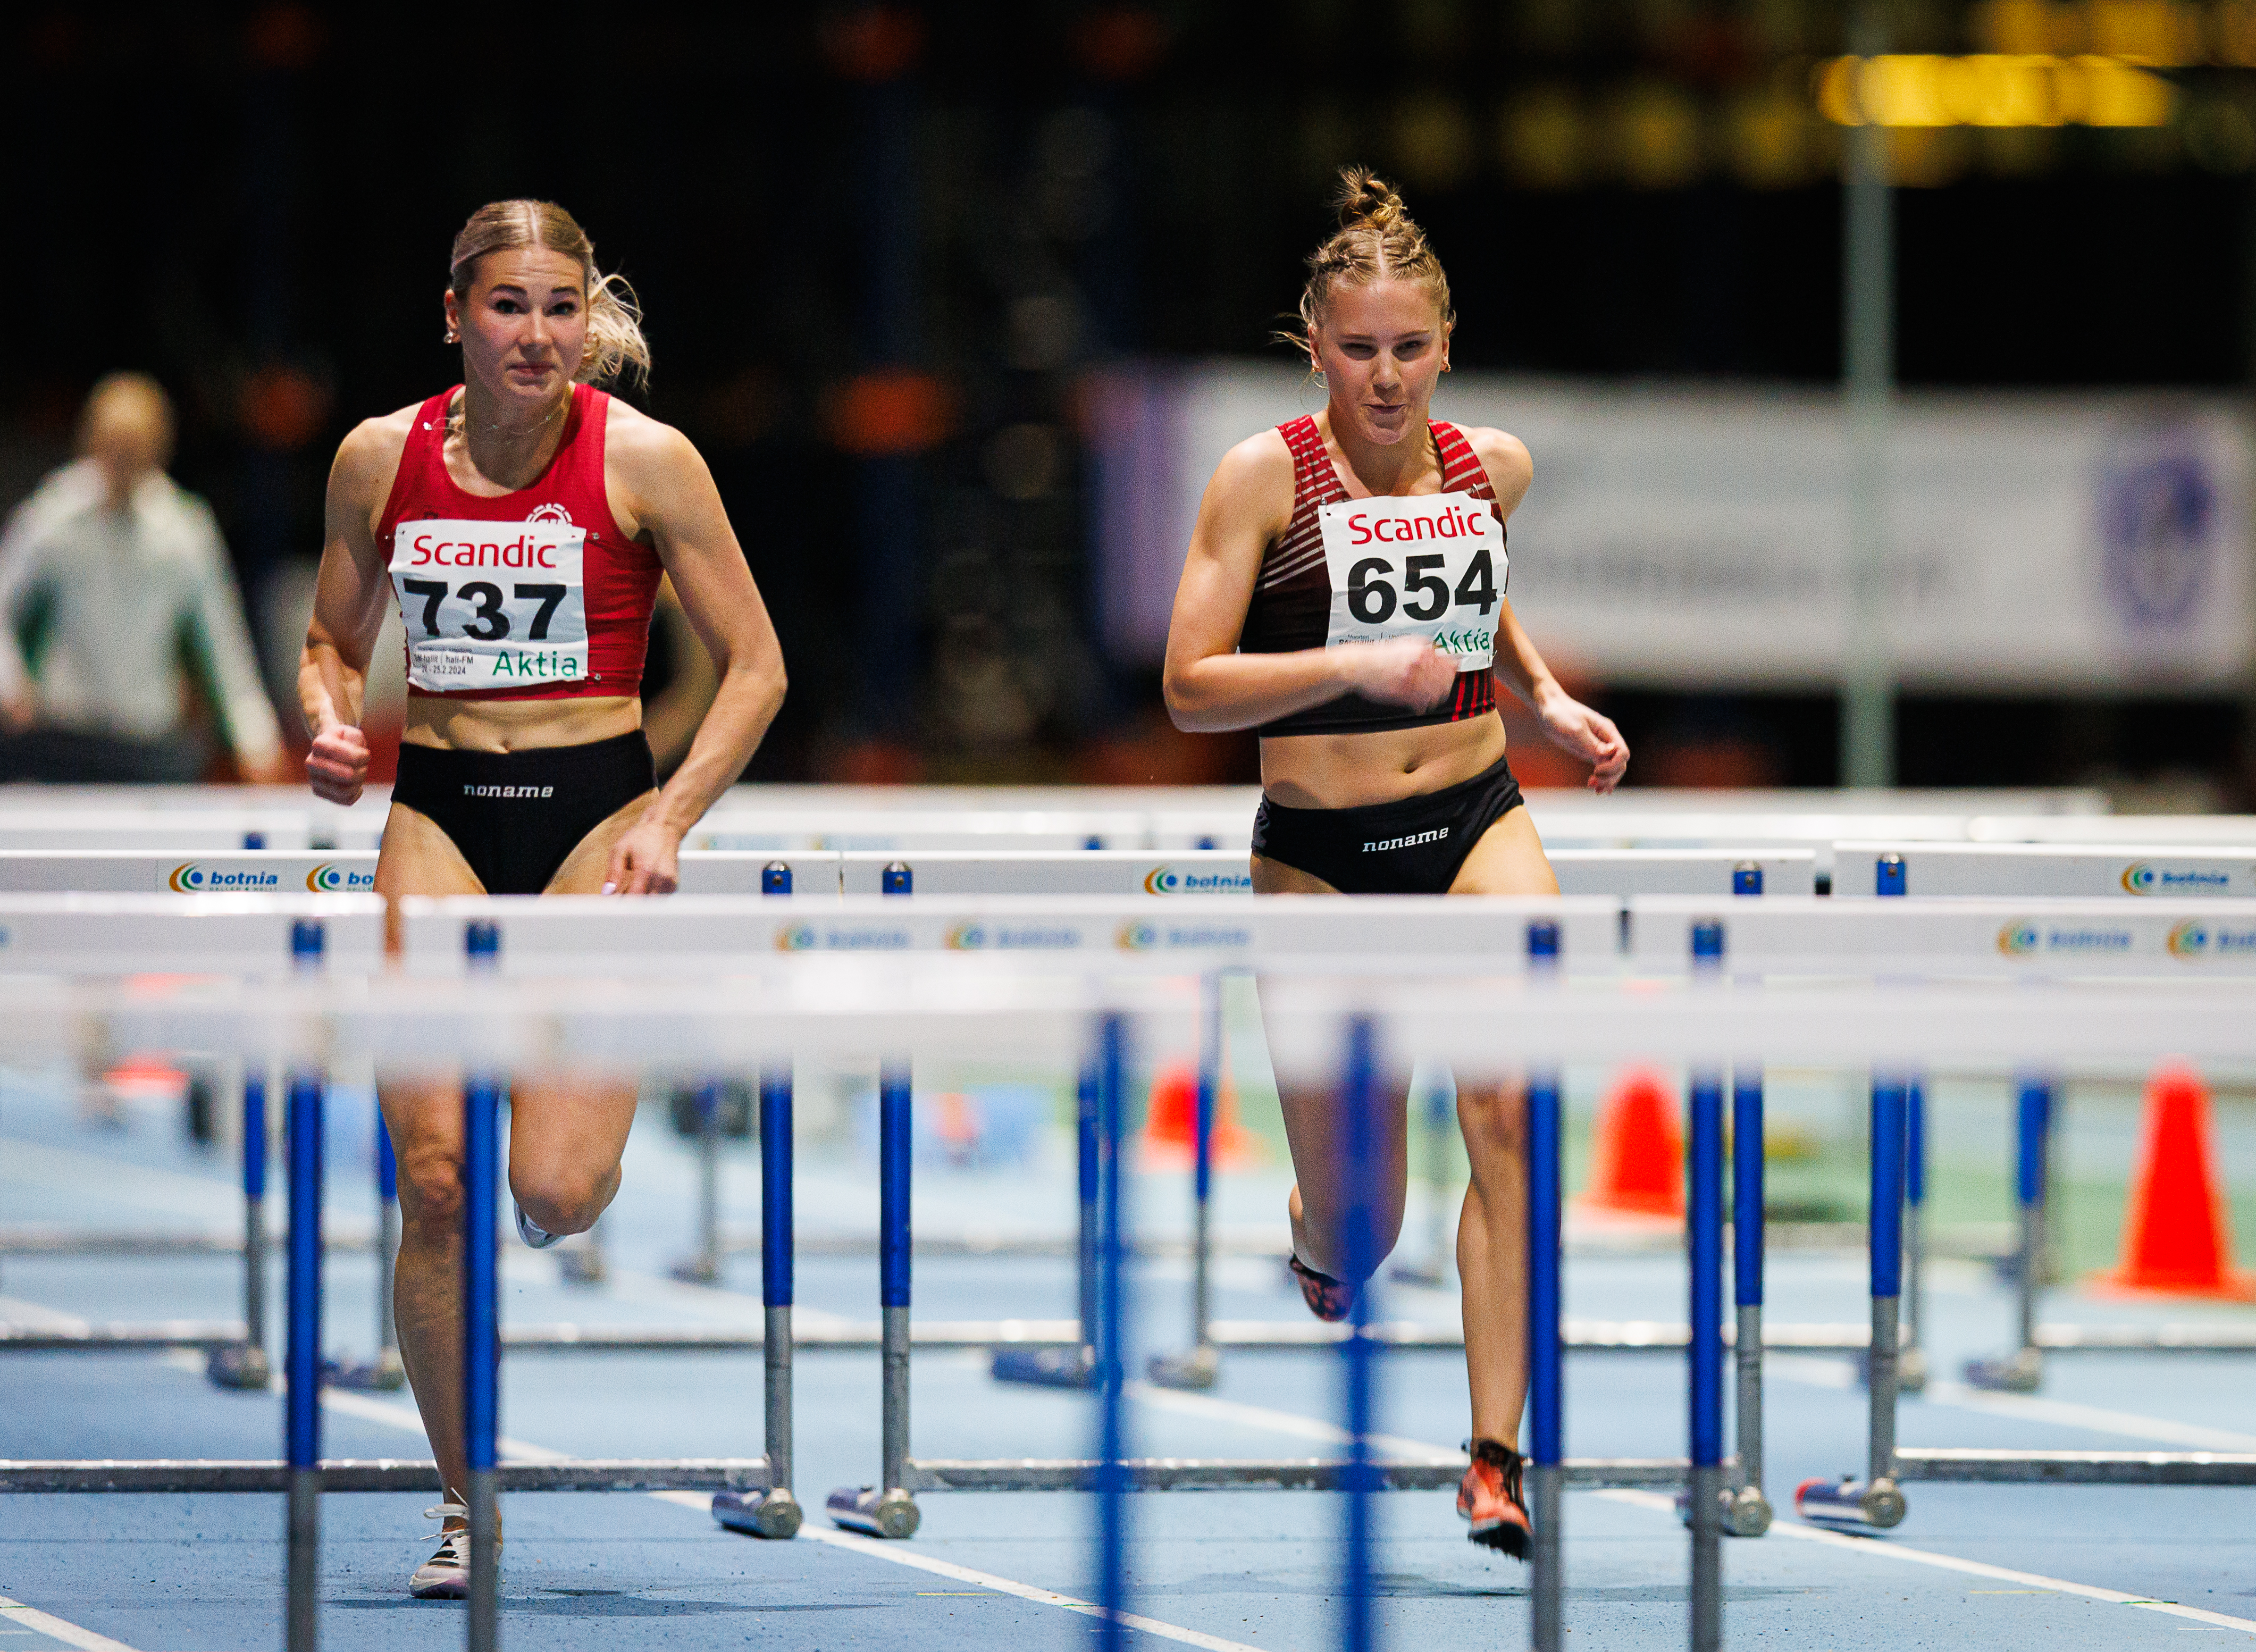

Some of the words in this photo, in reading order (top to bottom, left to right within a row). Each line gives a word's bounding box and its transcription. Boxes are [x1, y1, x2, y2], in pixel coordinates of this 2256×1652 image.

[1348, 506, 1485, 545] Scandic
[411, 535, 557, 568] Scandic
[1347, 549, 1498, 624] 654
[403, 578, 567, 641] 737
[1432, 628, 1489, 654] Aktia
[492, 650, 578, 677] Aktia
[464, 785, 553, 798] noname
[1362, 827, 1449, 852] noname
[211, 871, 278, 885] botnia
[1186, 875, 1251, 887] botnia
